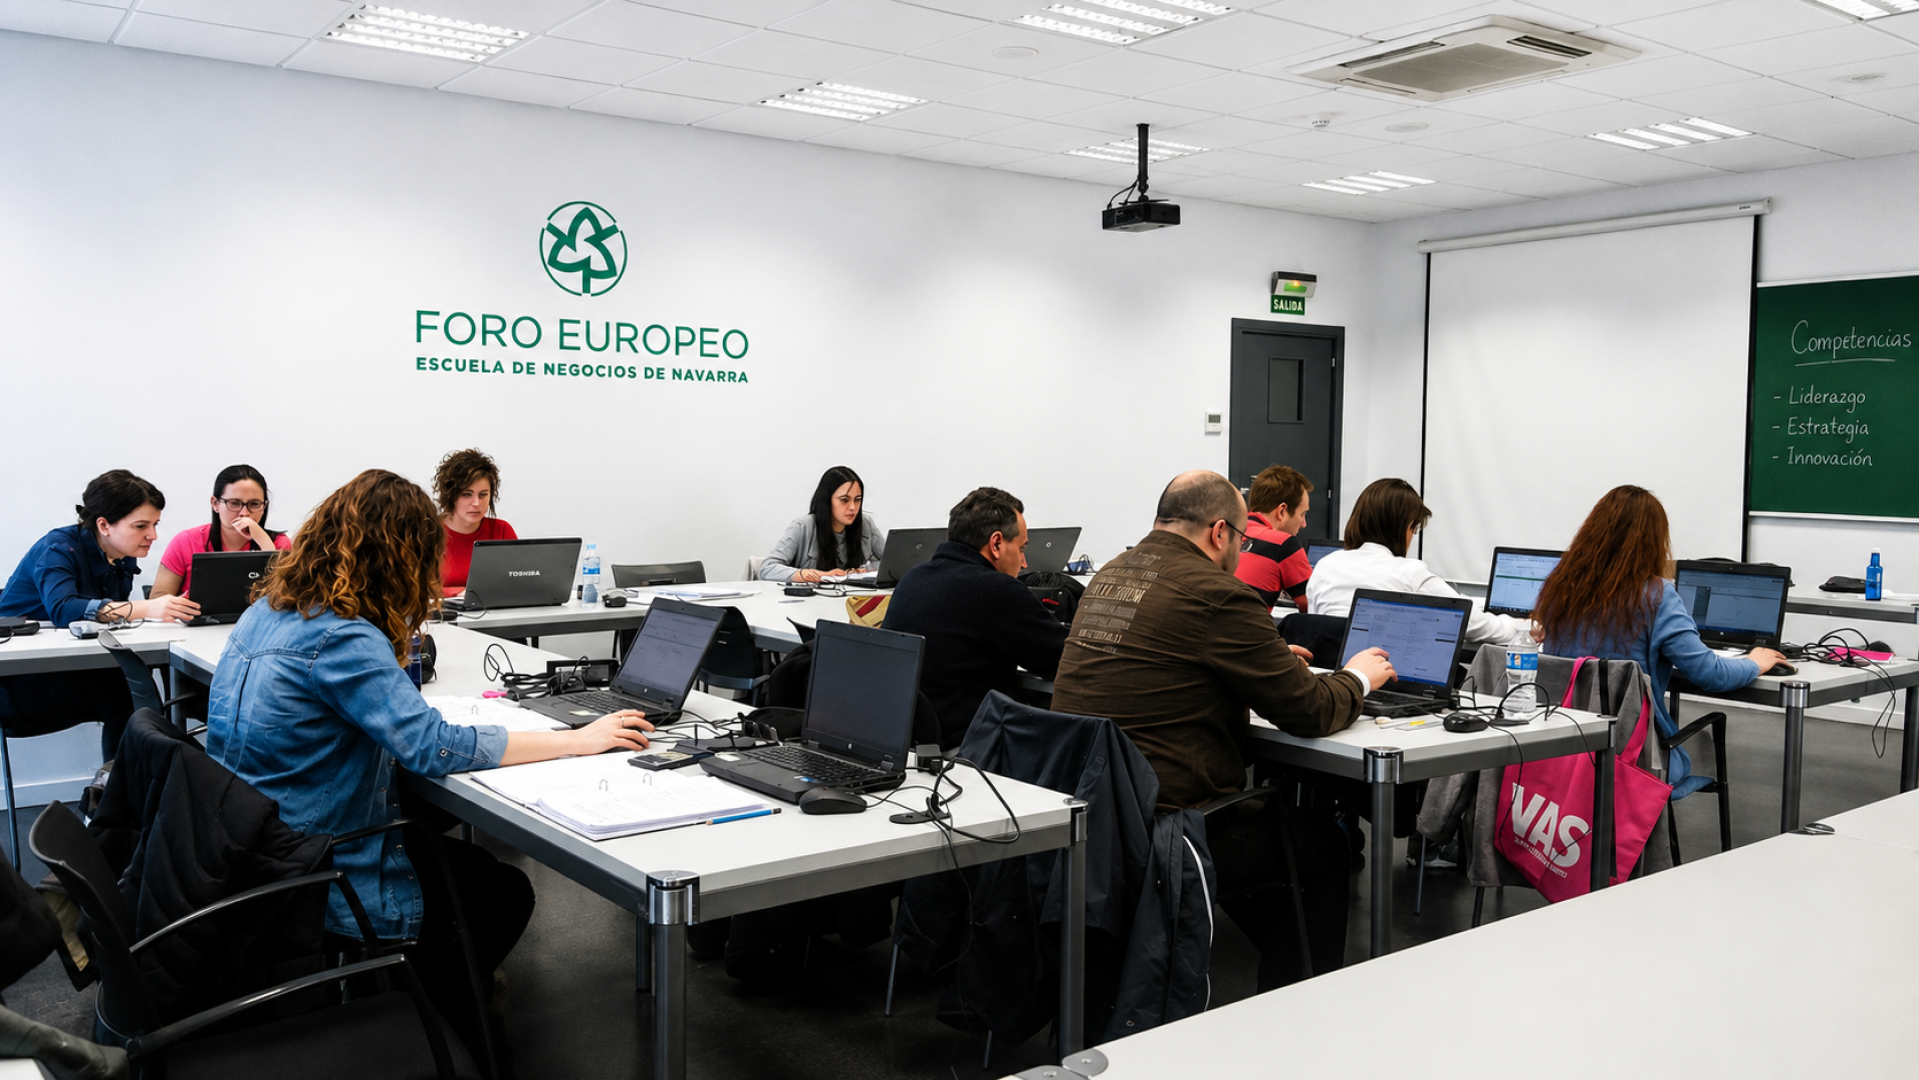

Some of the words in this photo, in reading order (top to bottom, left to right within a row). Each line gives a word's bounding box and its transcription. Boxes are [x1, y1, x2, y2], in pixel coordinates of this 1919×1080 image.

[1274, 298, 1303, 312] SALIDA
[416, 310, 542, 348] FORO
[559, 319, 749, 360] EUROPEO
[1791, 320, 1912, 358] Competencias
[416, 357, 504, 374] ESCUELA
[512, 361, 536, 375] DE
[544, 363, 637, 379] NEGOCIOS
[644, 367, 665, 380] DE
[672, 369, 749, 383] NAVARRA
[1789, 385, 1866, 413] Liderazgo
[1788, 417, 1869, 444] Estrategia
[1788, 446, 1873, 466] Innovación
